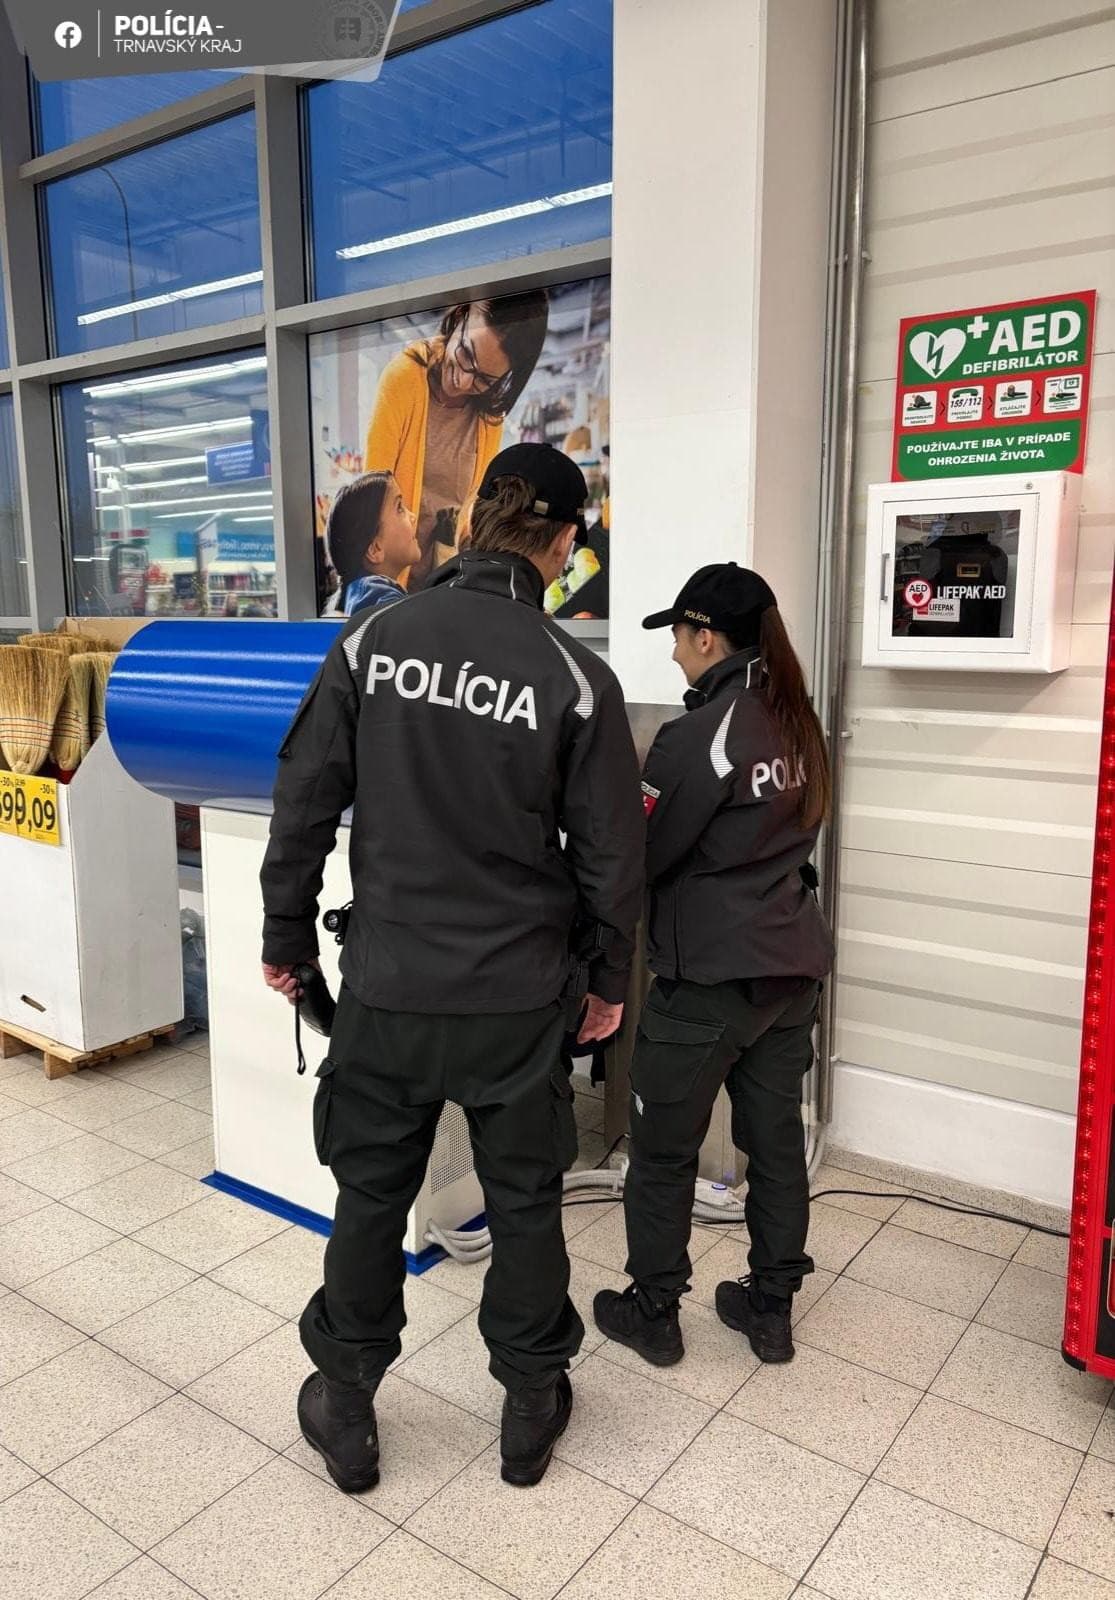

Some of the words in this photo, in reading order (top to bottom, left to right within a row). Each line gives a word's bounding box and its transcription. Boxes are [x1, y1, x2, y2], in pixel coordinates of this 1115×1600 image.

[988, 310, 1081, 355] AED
[962, 350, 1079, 375] DEFIBRILÁTOR
[950, 397, 982, 408] 155/112
[906, 440, 979, 454] POUŽÍVAJTE
[982, 438, 1003, 449] IBA
[1005, 436, 1015, 446] V
[1017, 431, 1071, 446] PRÍPADE
[928, 453, 997, 467] OHROZENIA
[1000, 449, 1045, 461] ŽIVOTA
[908, 584, 928, 593] AED
[936, 585, 981, 600] LIFEPAK
[983, 585, 1006, 599] AED
[929, 603, 954, 611] LIFEPAK
[684, 609, 711, 624] POLÍCIA
[365, 653, 538, 730] POLÍCIA
